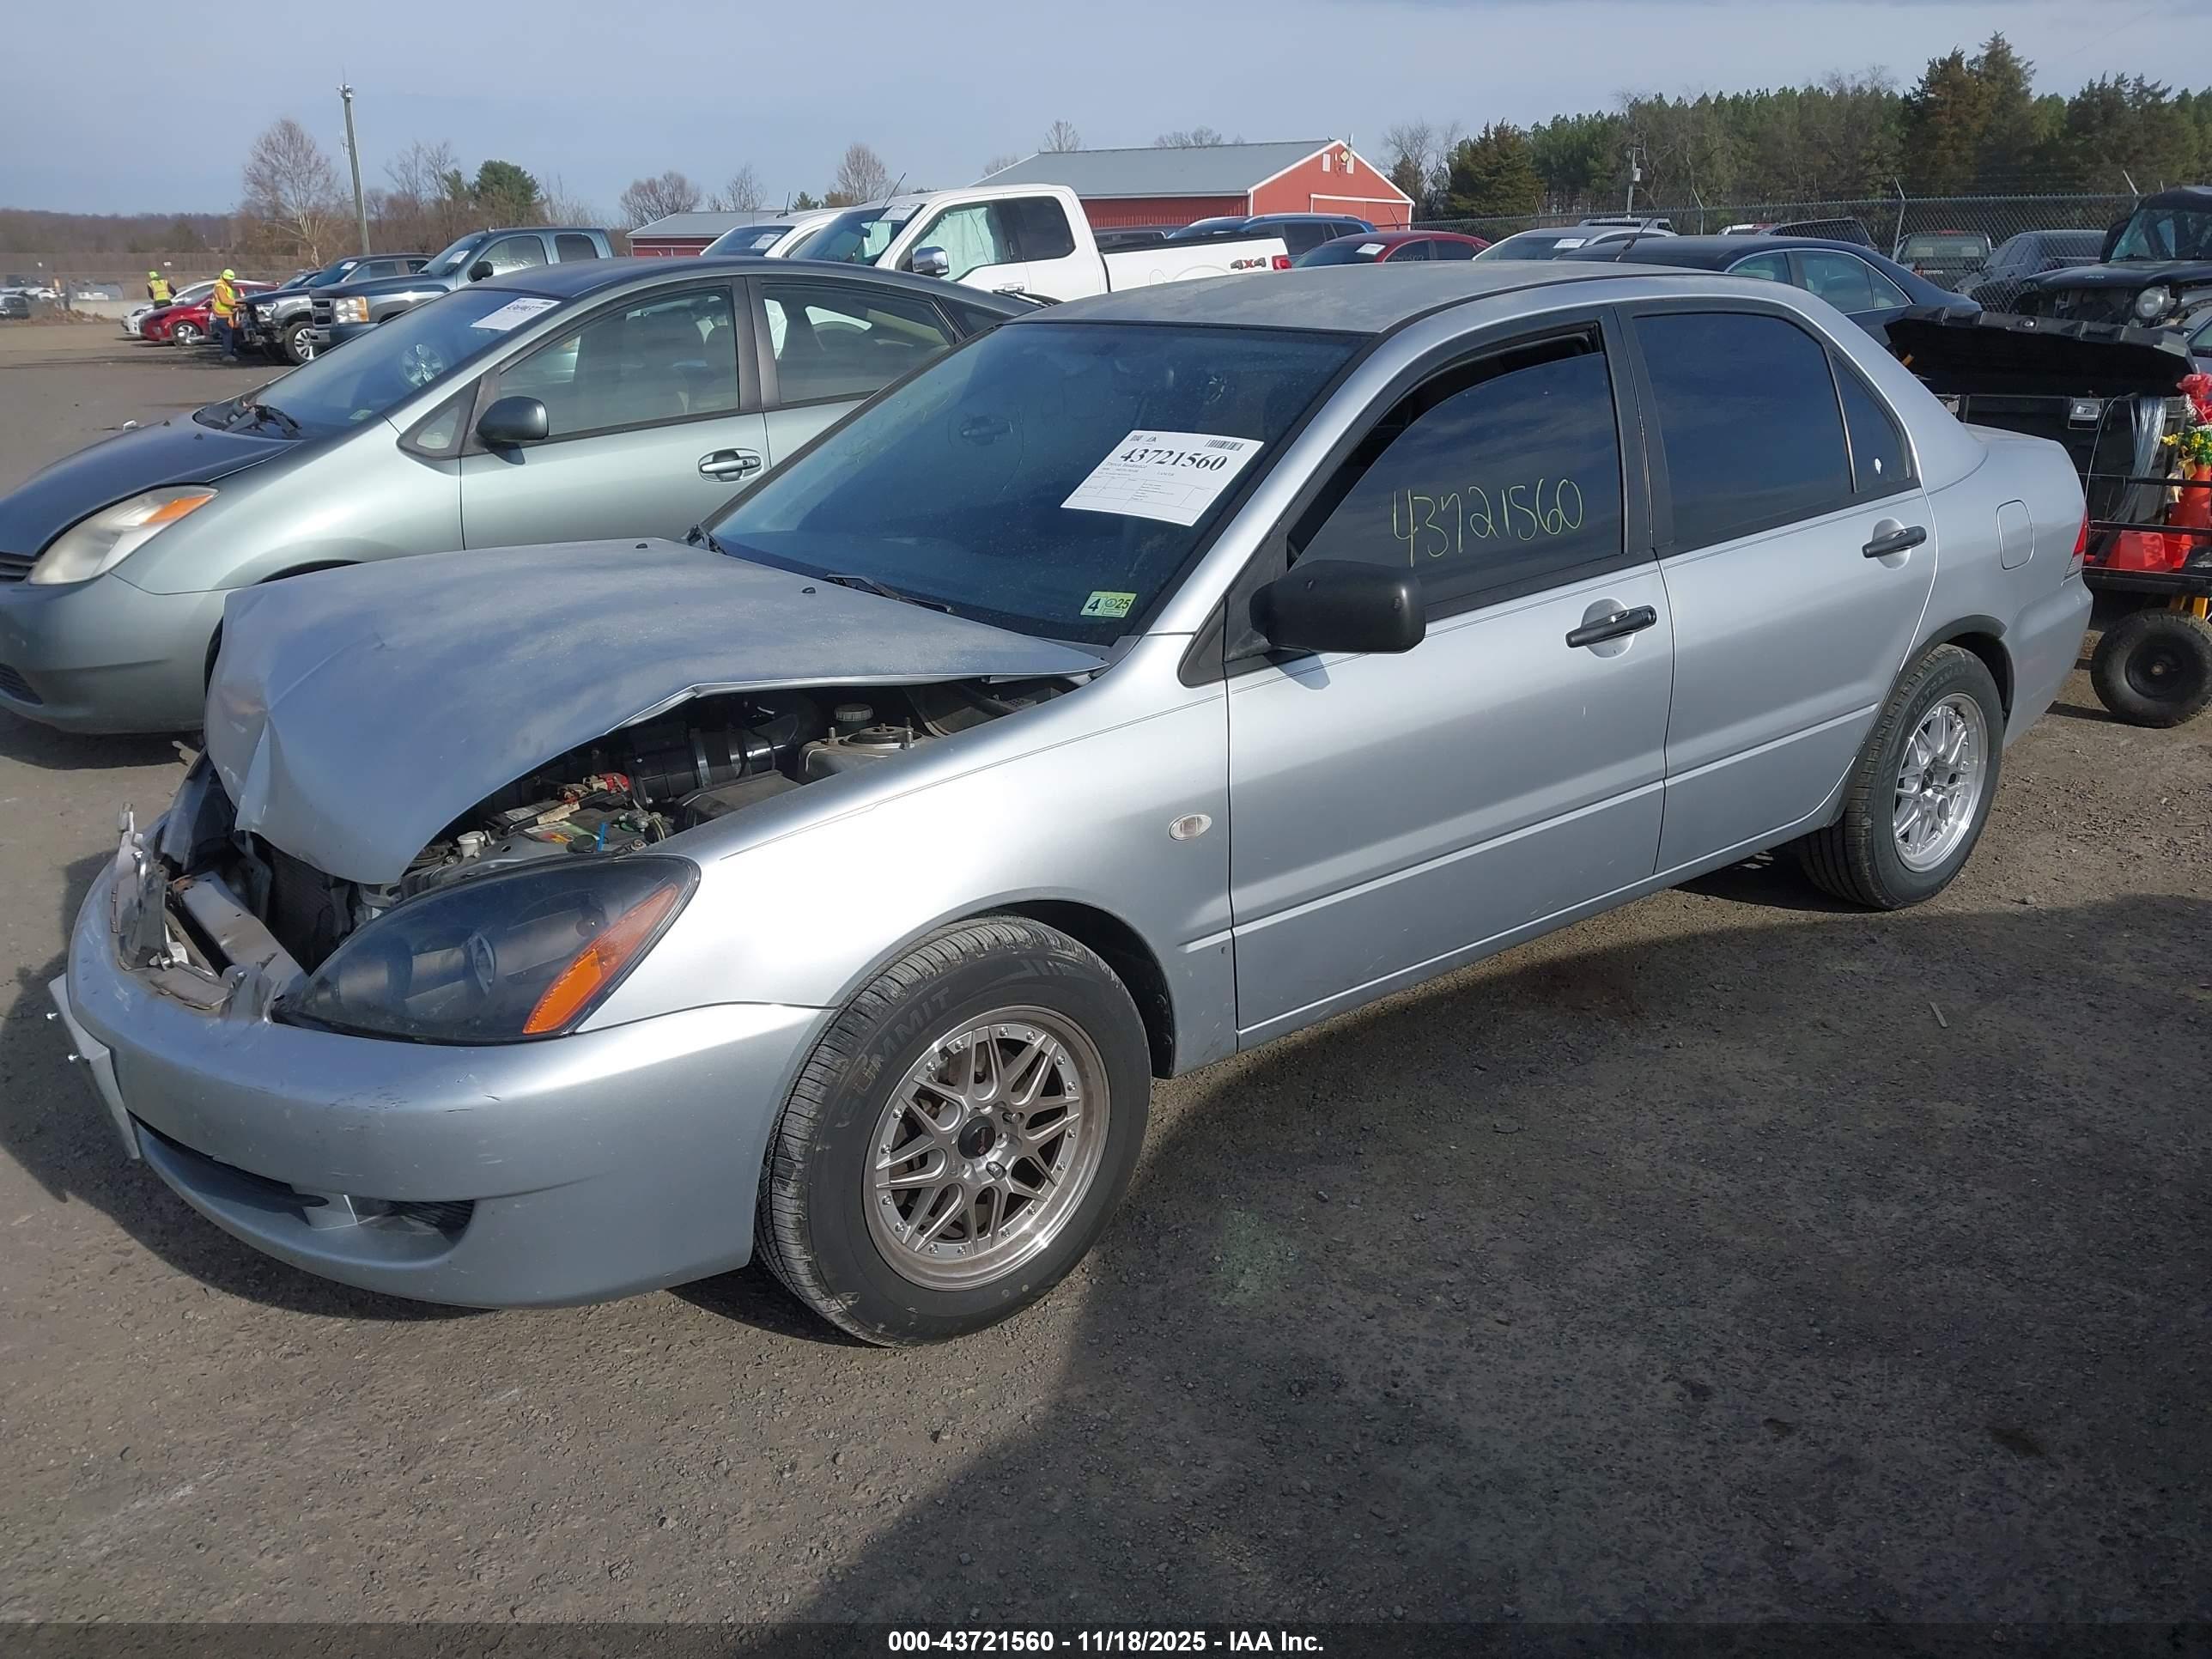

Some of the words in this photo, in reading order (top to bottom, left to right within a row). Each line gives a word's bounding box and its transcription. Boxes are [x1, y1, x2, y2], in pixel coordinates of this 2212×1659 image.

[1120, 447, 1228, 471] 43721560
[1392, 477, 1584, 568] 43721560
[1087, 598, 1102, 612] 4
[1114, 598, 1132, 610] 25
